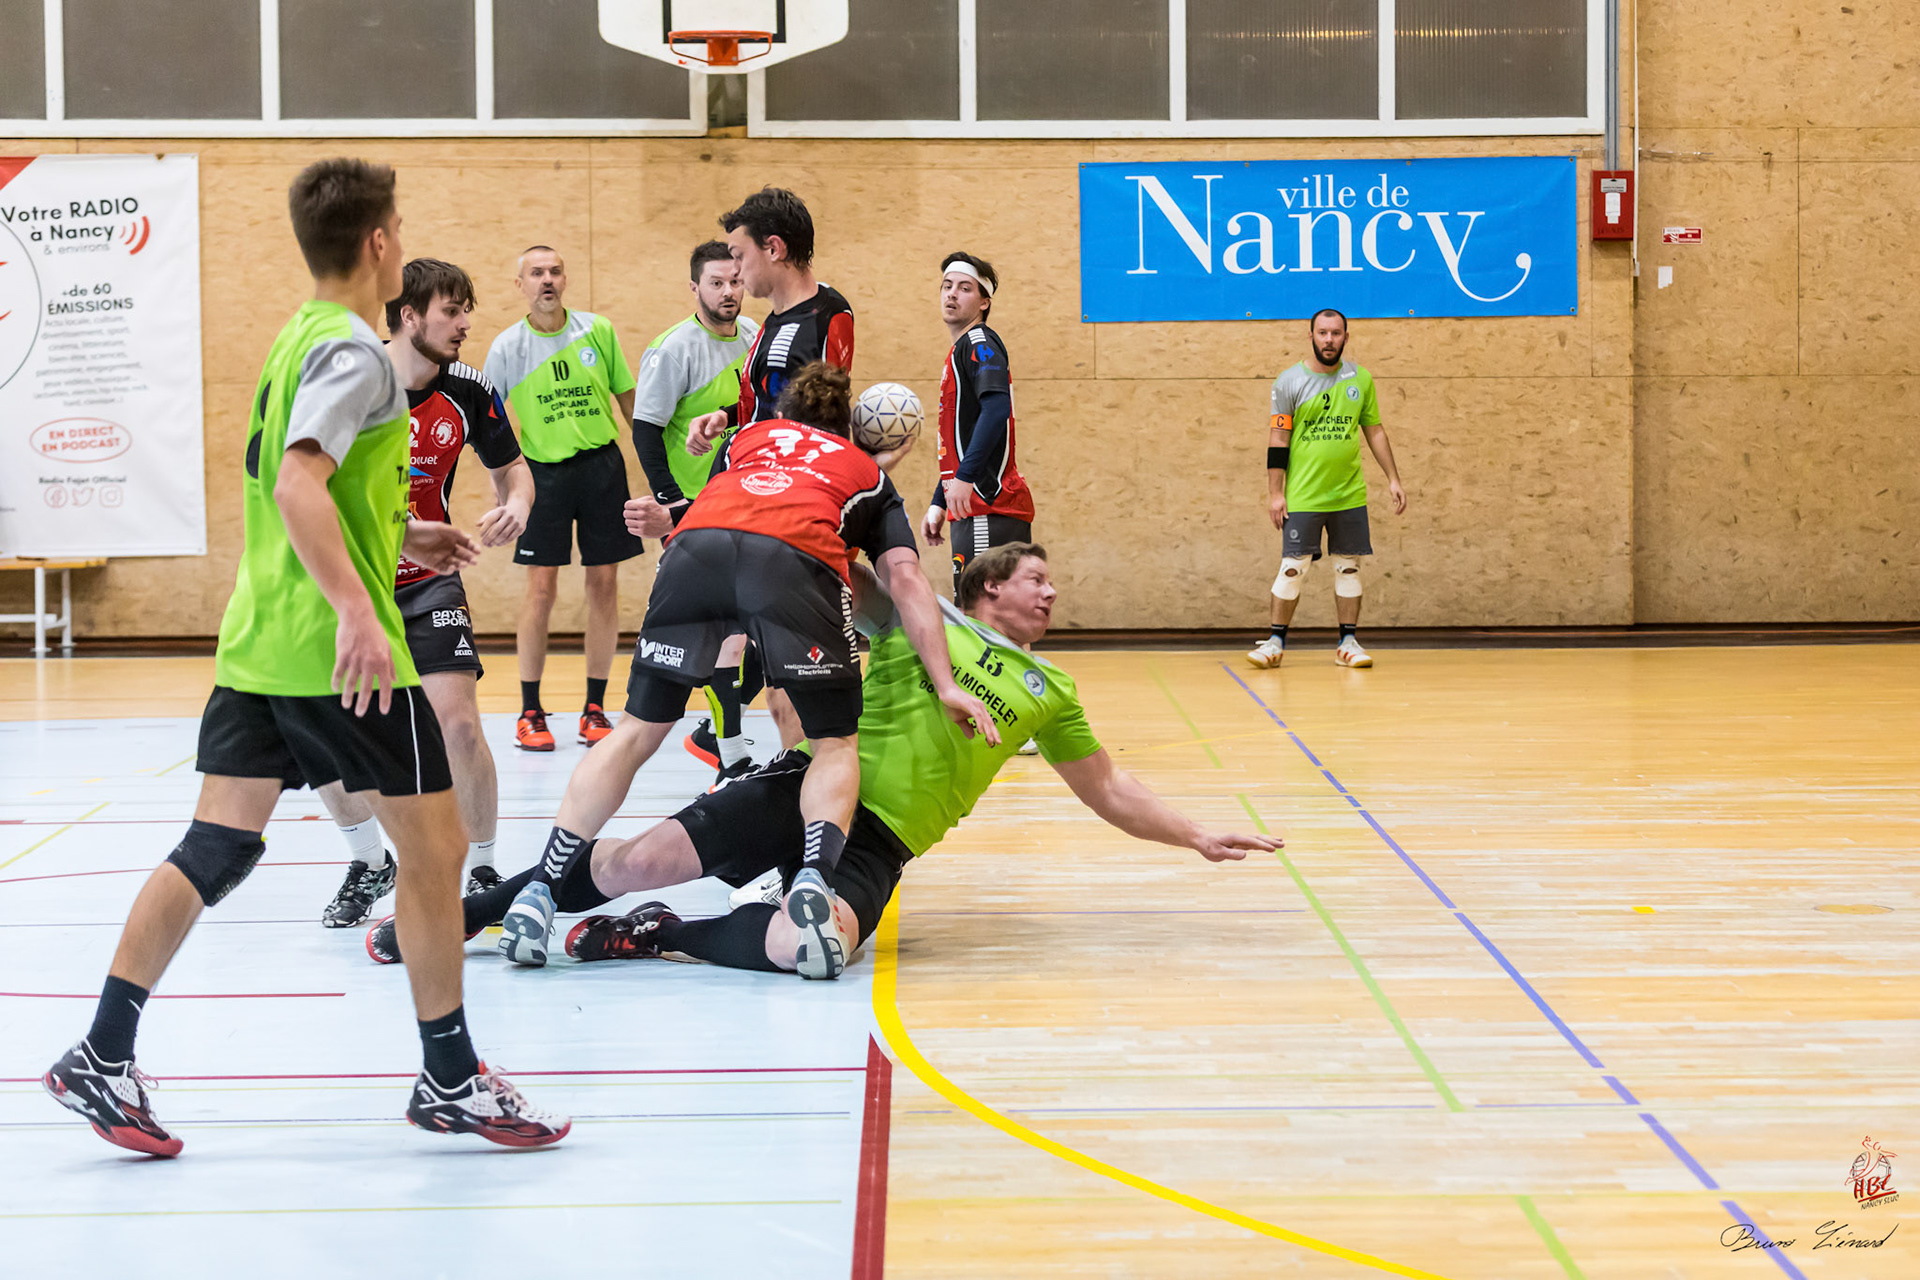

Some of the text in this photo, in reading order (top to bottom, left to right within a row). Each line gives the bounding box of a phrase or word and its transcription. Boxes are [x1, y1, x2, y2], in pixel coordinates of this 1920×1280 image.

[1277, 172, 1409, 209] ville de
[1, 197, 138, 222] Votre RADIO
[30, 224, 114, 241] à Nancy
[1125, 174, 1532, 302] Nancy
[58, 242, 110, 255] environs
[93, 283, 112, 295] 60
[48, 298, 134, 315] ÉMISSIONS
[551, 360, 570, 381] 10
[1322, 393, 1331, 410] 2
[575, 409, 586, 417] 56
[589, 408, 600, 416] 66
[1276, 416, 1285, 428] C
[69, 426, 114, 439] DIRECT
[62, 437, 120, 450] PODCAST
[432, 609, 463, 619] PAYS
[433, 618, 469, 628] SPORT
[655, 642, 685, 658] INTER
[653, 652, 683, 668] SPORT
[976, 645, 1004, 677] 15
[960, 672, 1018, 728] MICHELET
